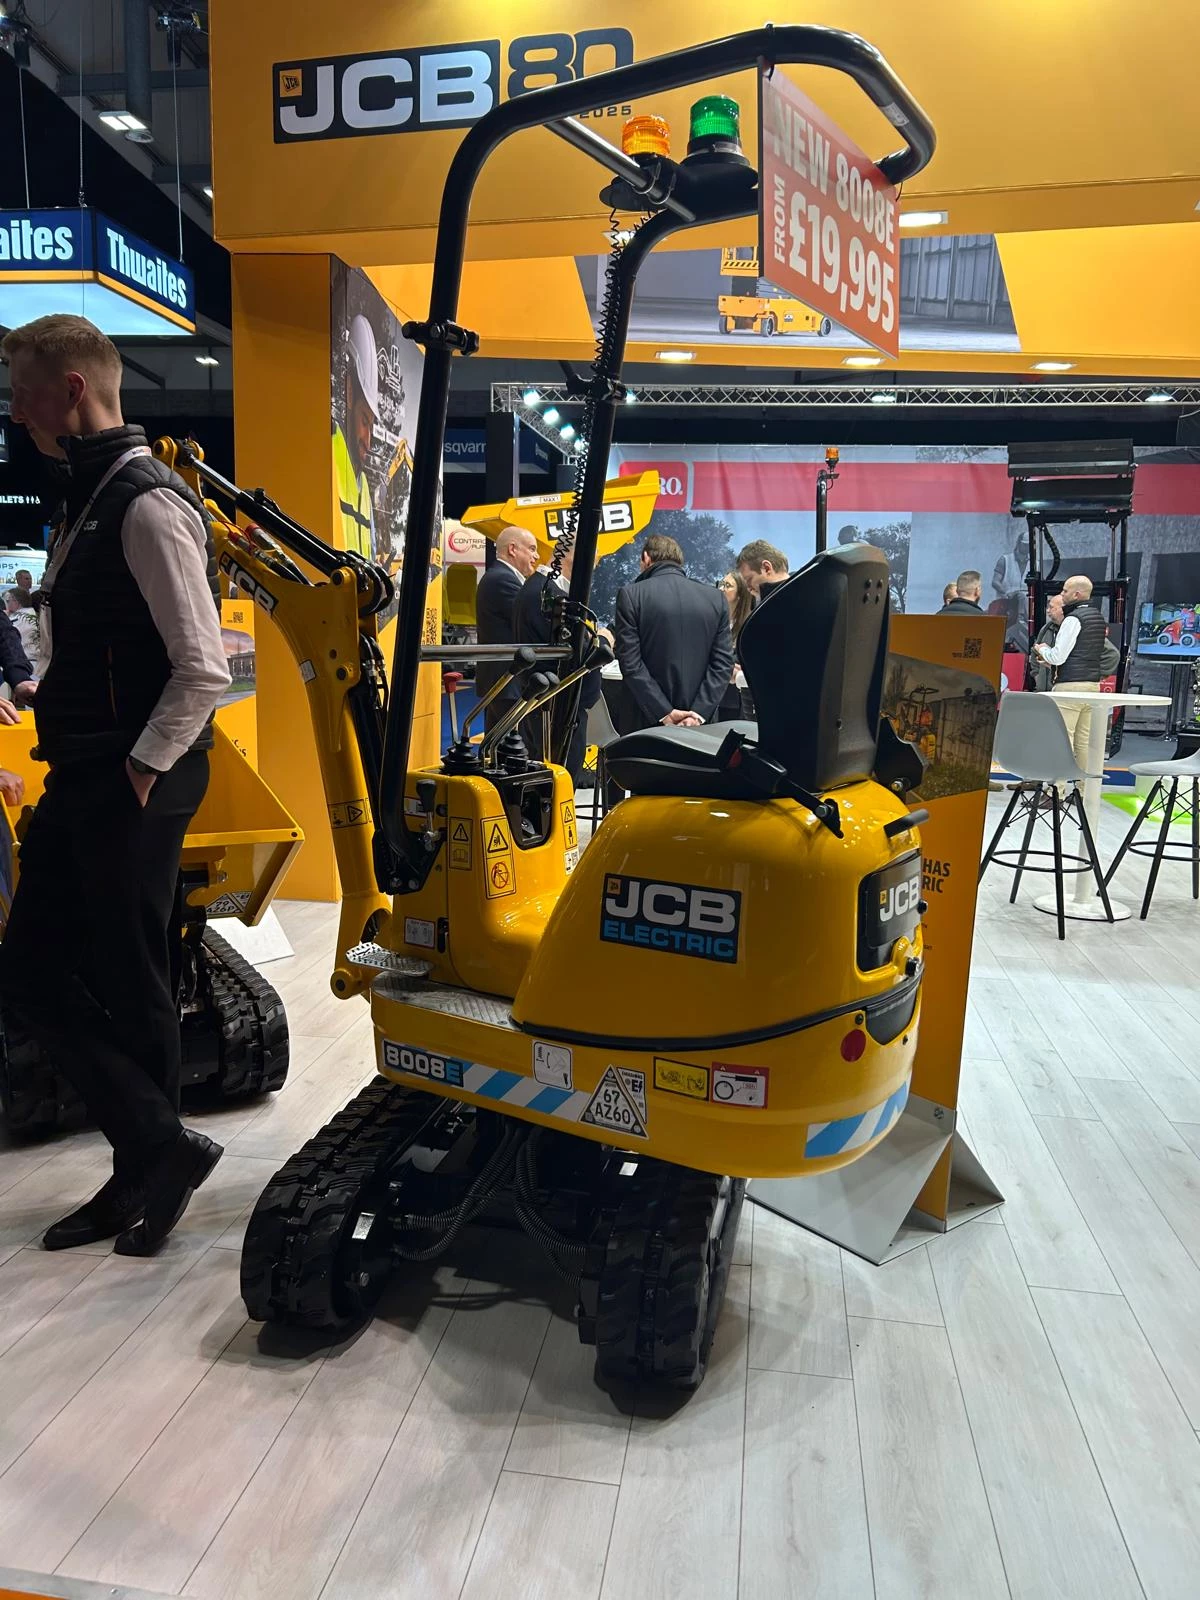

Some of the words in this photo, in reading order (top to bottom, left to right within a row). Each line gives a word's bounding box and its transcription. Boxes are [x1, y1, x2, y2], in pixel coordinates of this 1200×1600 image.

[280, 50, 493, 134] JCB
[773, 96, 831, 196] NEW
[836, 152, 894, 254] 8008E
[774, 173, 785, 264] FROM
[106, 227, 187, 309] Thwaites
[789, 190, 894, 334] £19,995
[922, 858, 951, 877] HAS
[605, 880, 736, 933] JCB
[880, 875, 919, 922] JCB
[603, 919, 734, 957] ELECTRIC
[386, 1045, 461, 1084] 8008E
[595, 1102, 631, 1125] AZ60
[603, 1089, 620, 1105] 67
